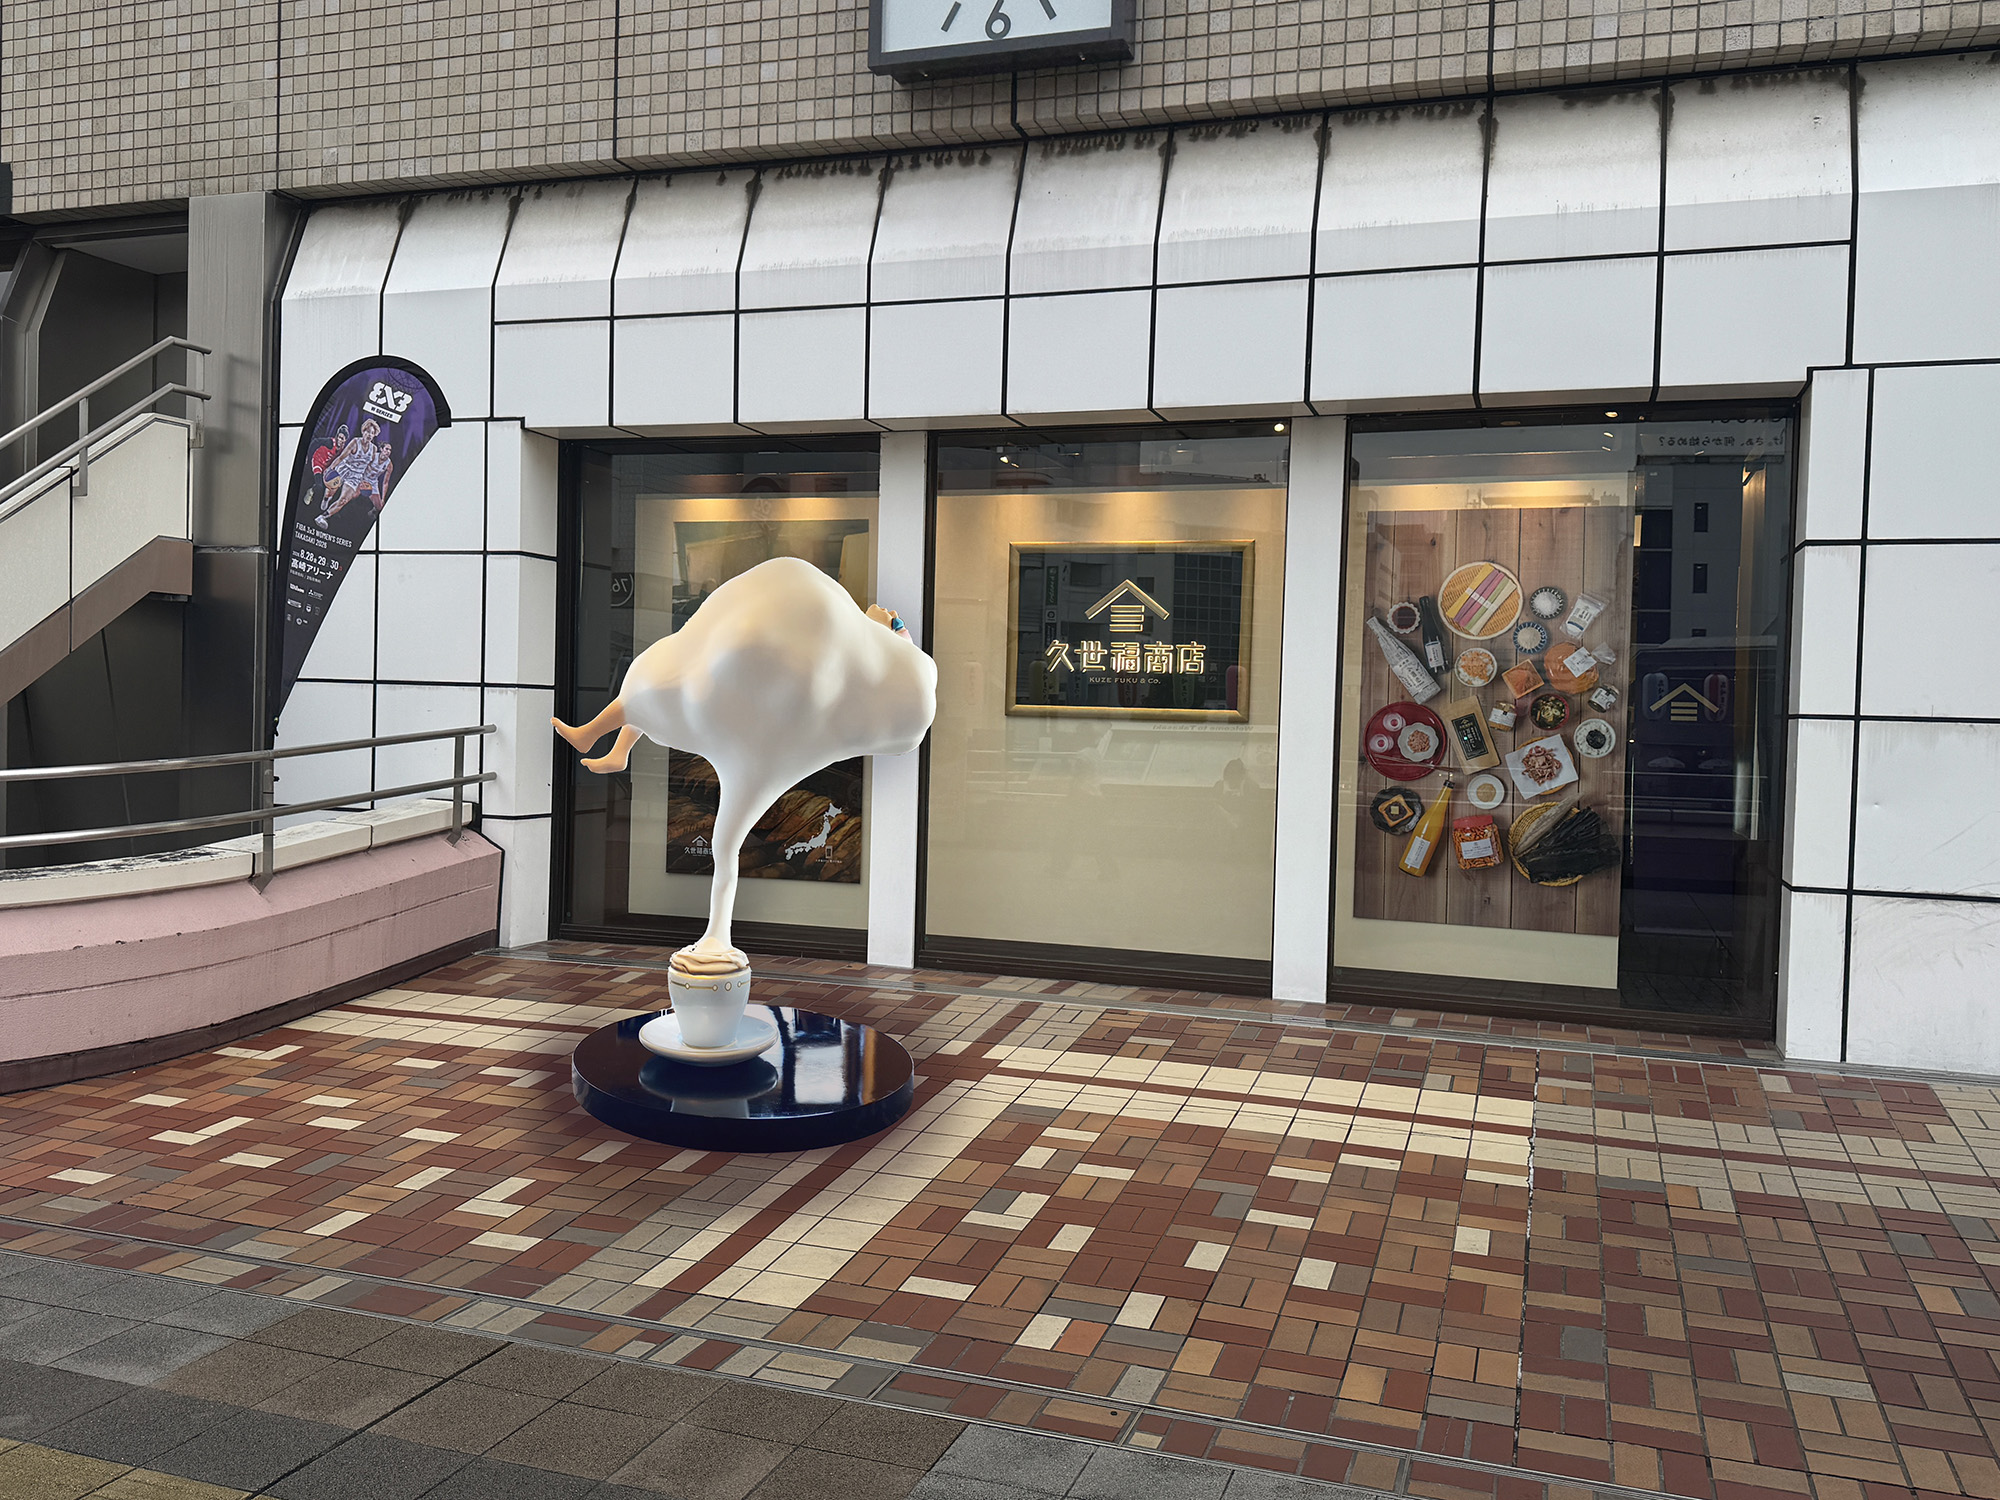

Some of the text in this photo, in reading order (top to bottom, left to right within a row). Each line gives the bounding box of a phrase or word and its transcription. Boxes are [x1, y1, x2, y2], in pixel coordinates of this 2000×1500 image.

[984, 0, 1012, 41] 6
[376, 408, 394, 419] SERIES
[295, 522, 306, 531] FIBA
[315, 530, 336, 543] WOMEN'S
[336, 537, 352, 548] SERIES
[295, 530, 328, 549] TAKASAKI 2026
[291, 558, 334, 580] 高崎アリーナ
[1044, 639, 1207, 675] 久世福商店
[1089, 676, 1161, 685] KUZE FUKU & Co.
